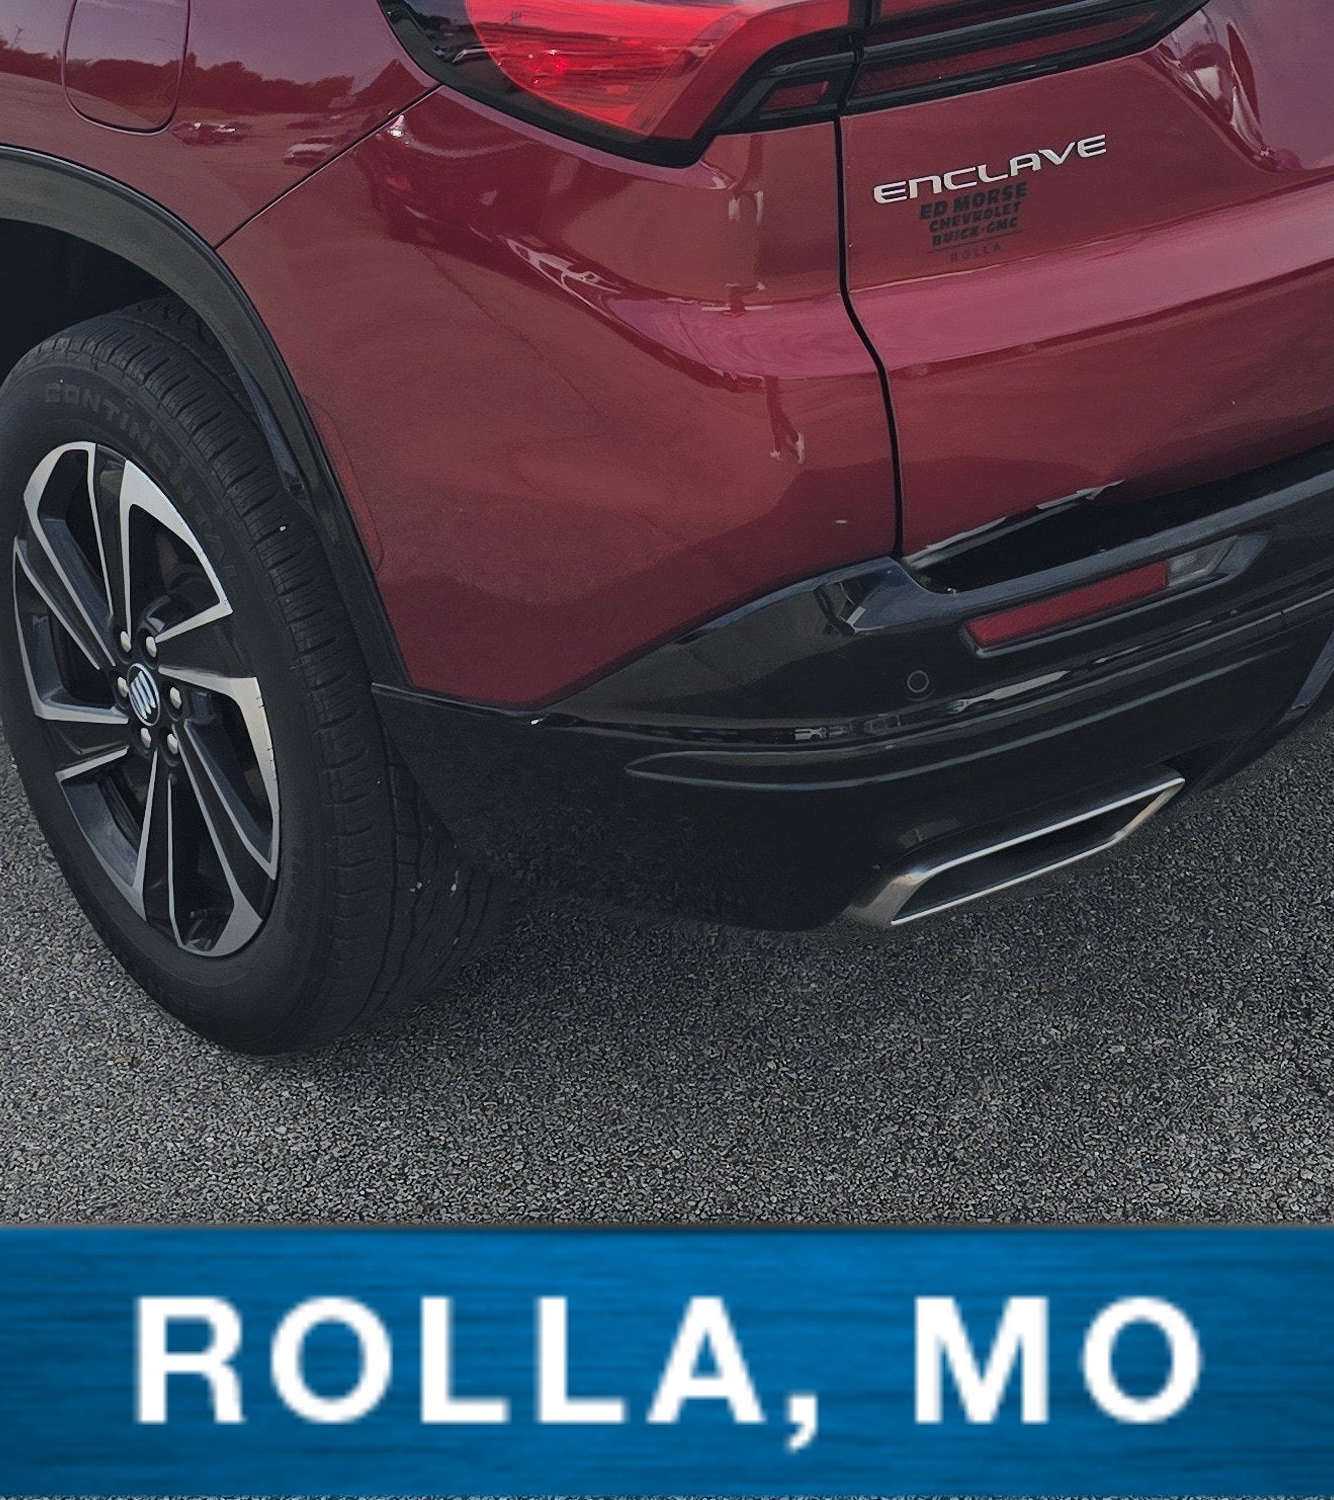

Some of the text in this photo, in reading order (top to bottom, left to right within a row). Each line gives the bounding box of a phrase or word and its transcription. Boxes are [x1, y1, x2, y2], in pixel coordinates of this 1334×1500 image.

[873, 133, 1107, 204] ENCLAVE
[920, 182, 1027, 220] ED MORSE
[929, 201, 1021, 233] CHEVROLET
